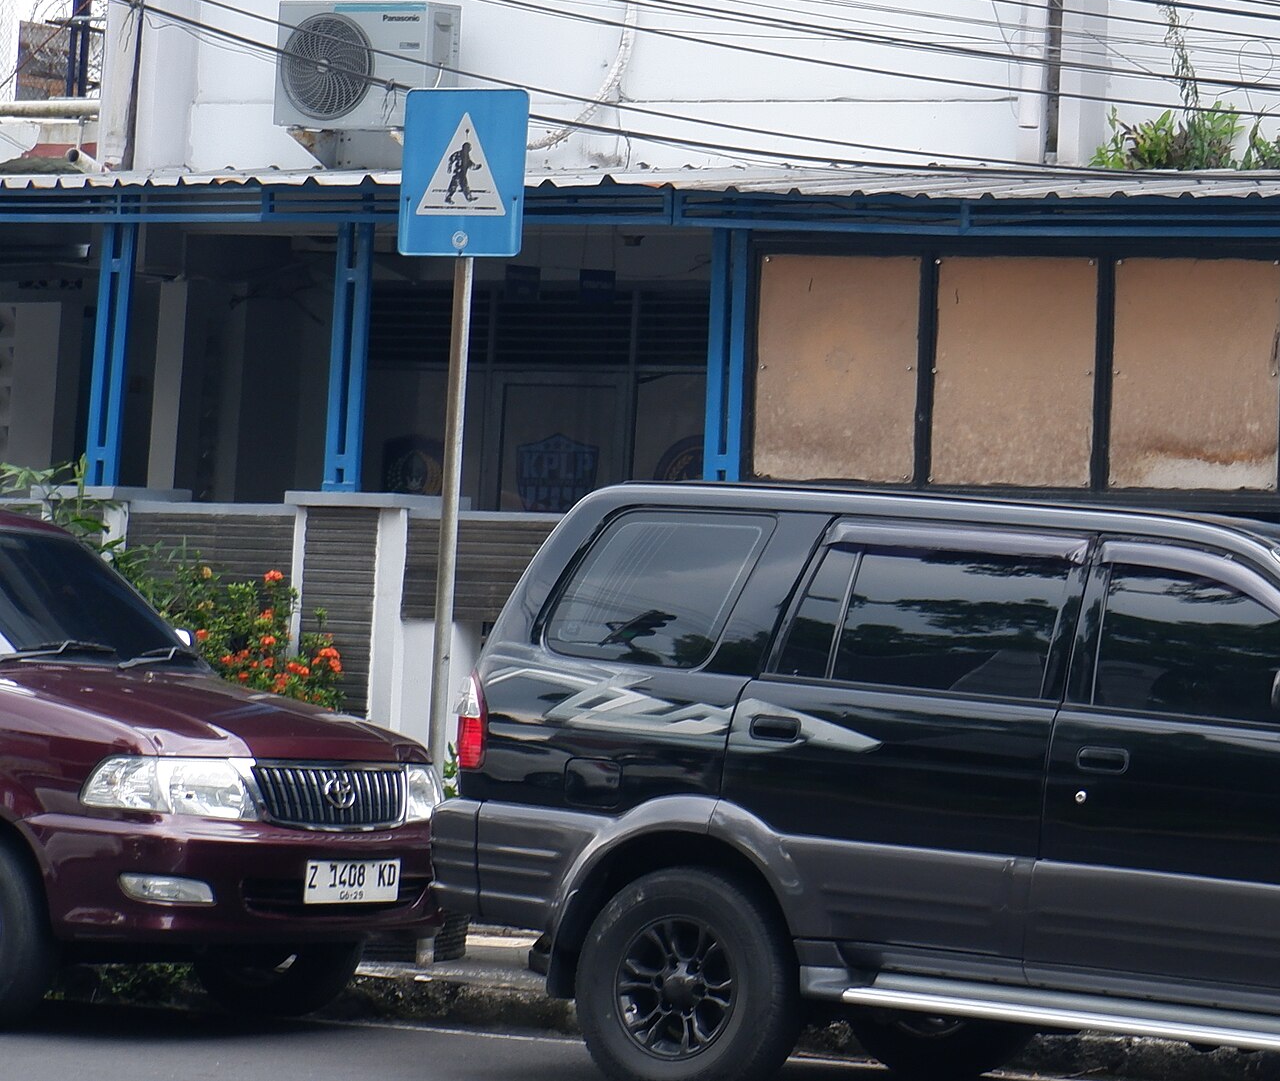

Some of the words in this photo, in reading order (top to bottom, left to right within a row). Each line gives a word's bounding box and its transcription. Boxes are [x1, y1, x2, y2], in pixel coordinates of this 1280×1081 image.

[382, 14, 420, 23] Panasonic
[307, 865, 319, 889] Z
[328, 863, 367, 888] 1408
[377, 863, 397, 887] KD
